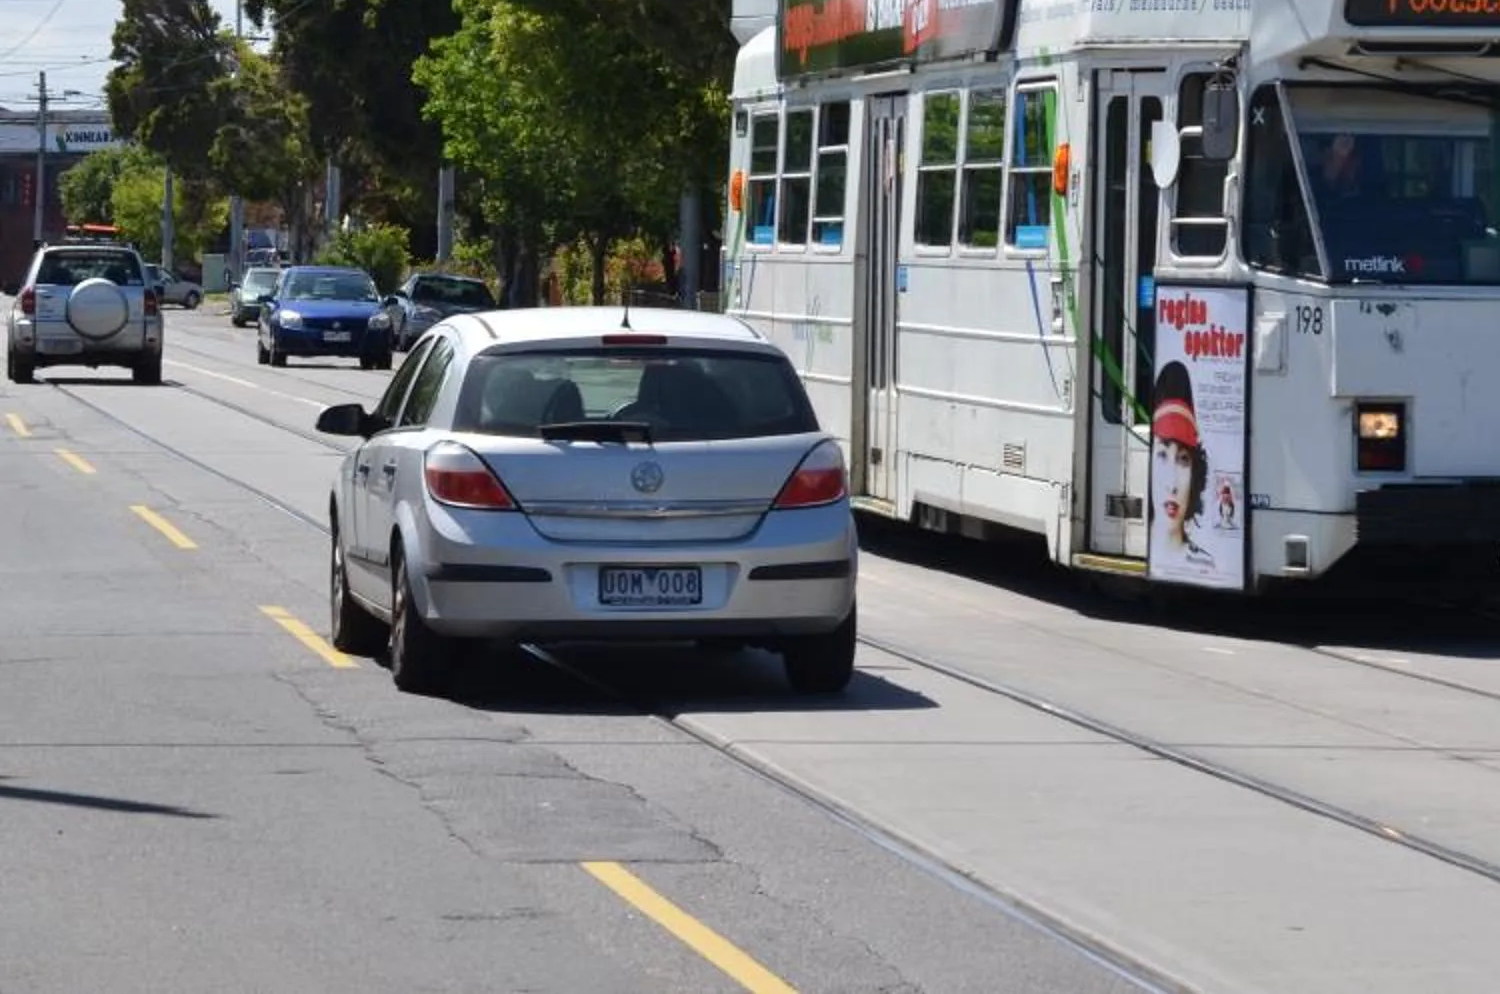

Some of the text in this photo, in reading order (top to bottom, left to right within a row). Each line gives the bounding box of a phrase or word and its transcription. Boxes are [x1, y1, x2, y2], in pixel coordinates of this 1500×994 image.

[1344, 255, 1406, 273] metlink
[1159, 292, 1207, 330] regina
[1295, 306, 1324, 335] 198
[1185, 324, 1244, 362] spektor
